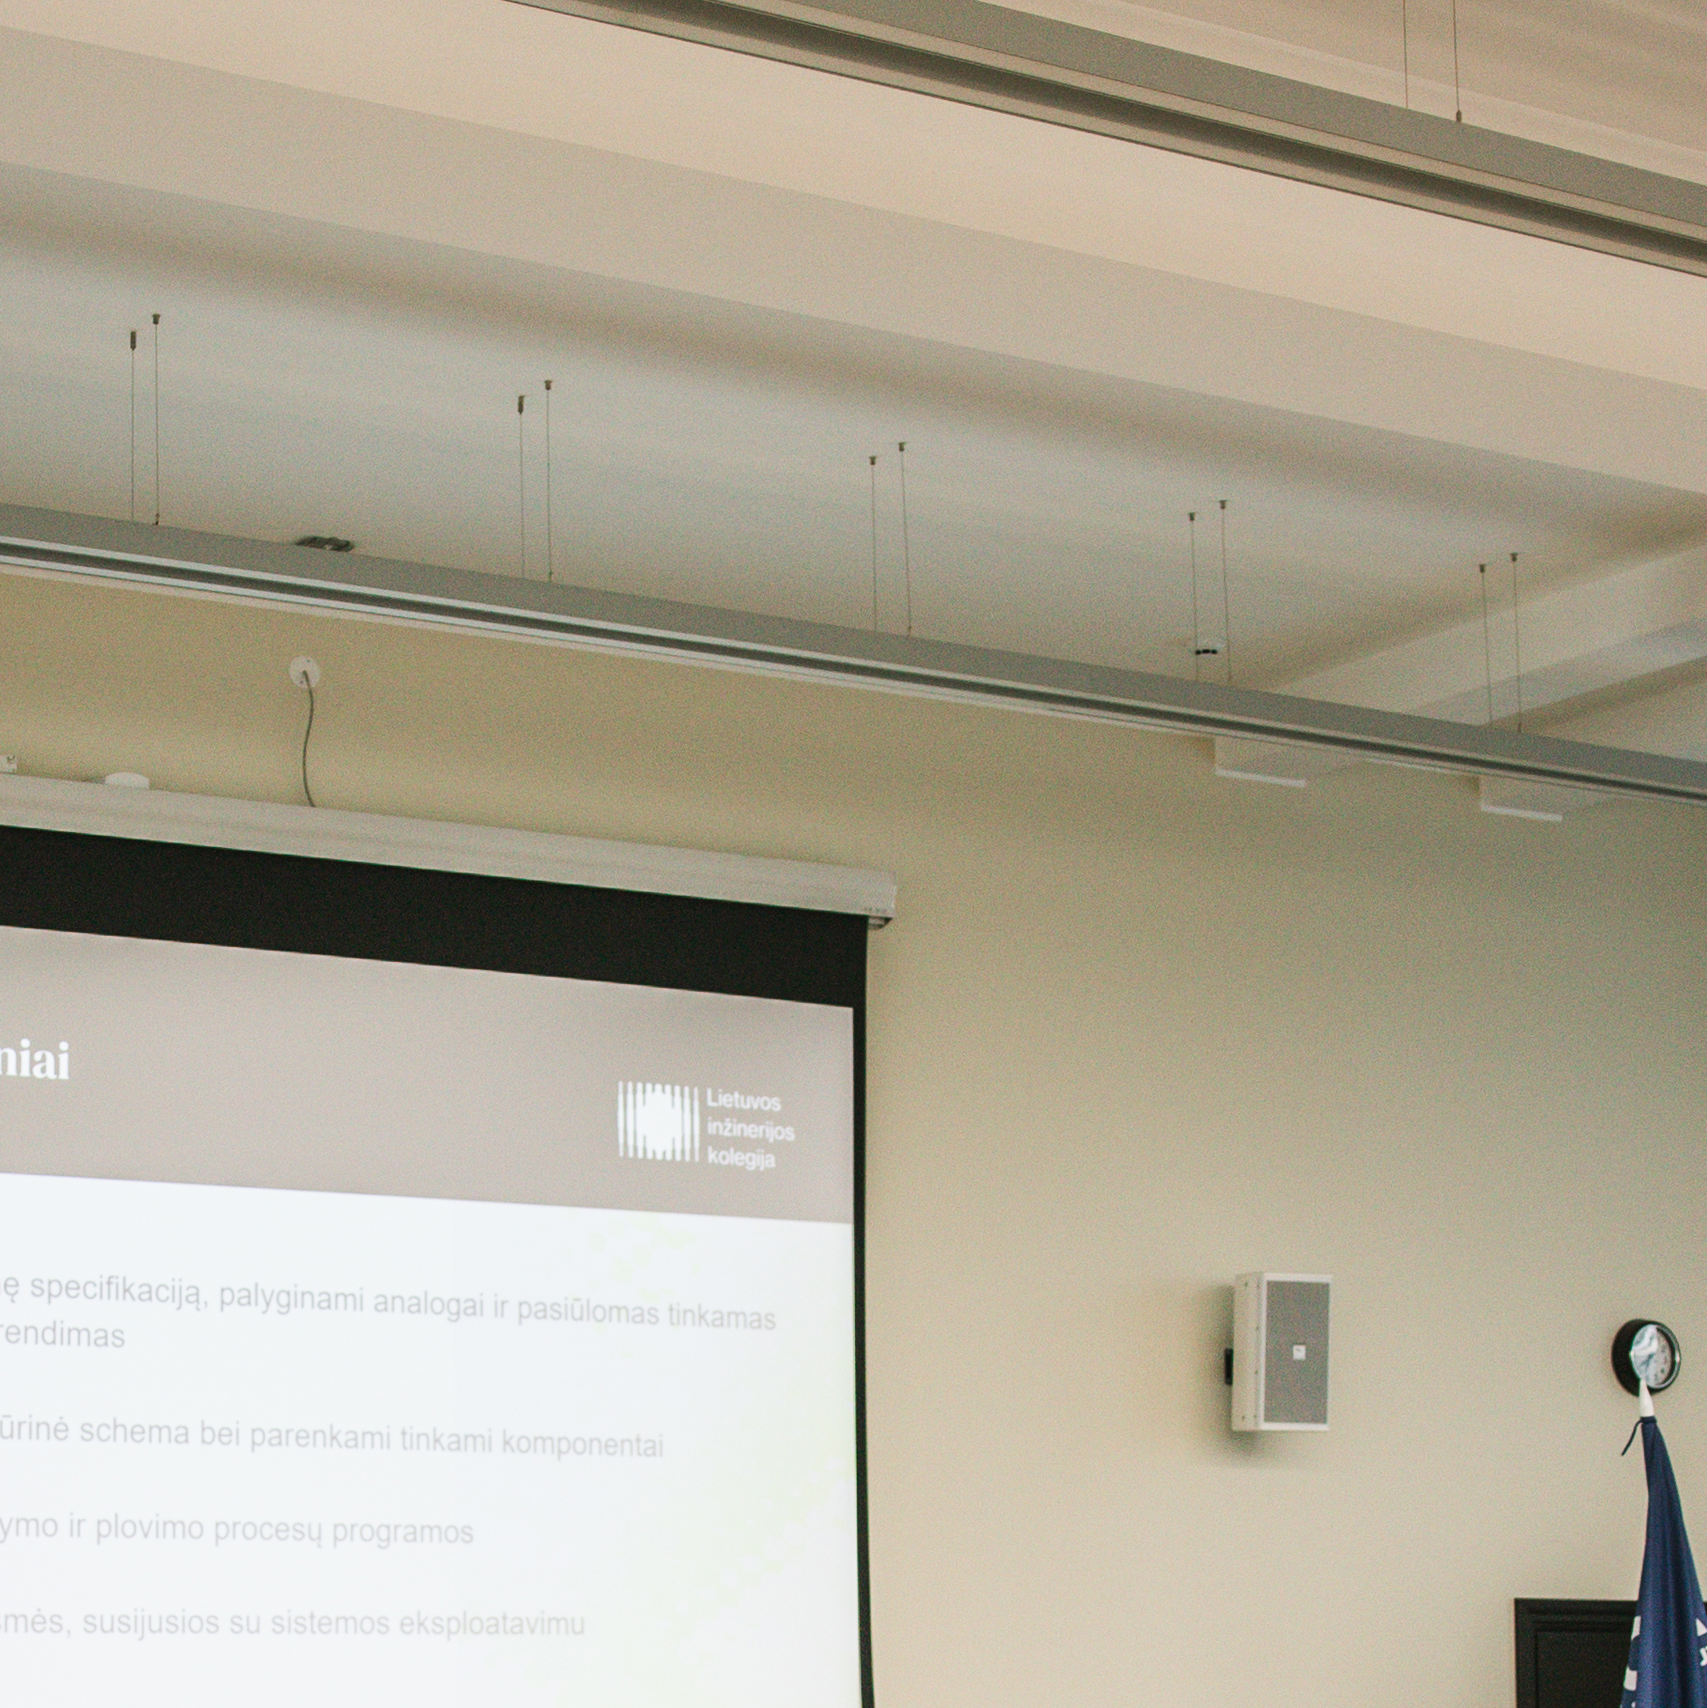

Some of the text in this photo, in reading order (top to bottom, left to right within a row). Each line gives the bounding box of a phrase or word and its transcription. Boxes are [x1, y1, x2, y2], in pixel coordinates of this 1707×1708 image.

[706, 1088, 782, 1113] Lietuvos
[707, 1116, 796, 1143] inžinerijos
[707, 1146, 776, 1171] kolegija
[219, 1281, 365, 1316] palyginami
[373, 1288, 485, 1324] analogai
[493, 1292, 510, 1319] ir
[517, 1296, 661, 1326] pasiūlomas
[667, 1302, 777, 1331] tinkamas
[79, 1416, 190, 1445] schema
[200, 1419, 241, 1447] bei
[250, 1423, 391, 1453] parenkami
[400, 1427, 493, 1453] tinkami
[501, 1428, 664, 1461] komponentai
[68, 1511, 88, 1539] ir
[95, 1512, 205, 1546] plovimo
[213, 1519, 323, 1549] procesų
[332, 1522, 475, 1551] programos
[82, 1608, 221, 1642] susijusios
[229, 1614, 261, 1635] su
[270, 1609, 391, 1636] sistemos
[399, 1610, 586, 1642] eksploatavimu
